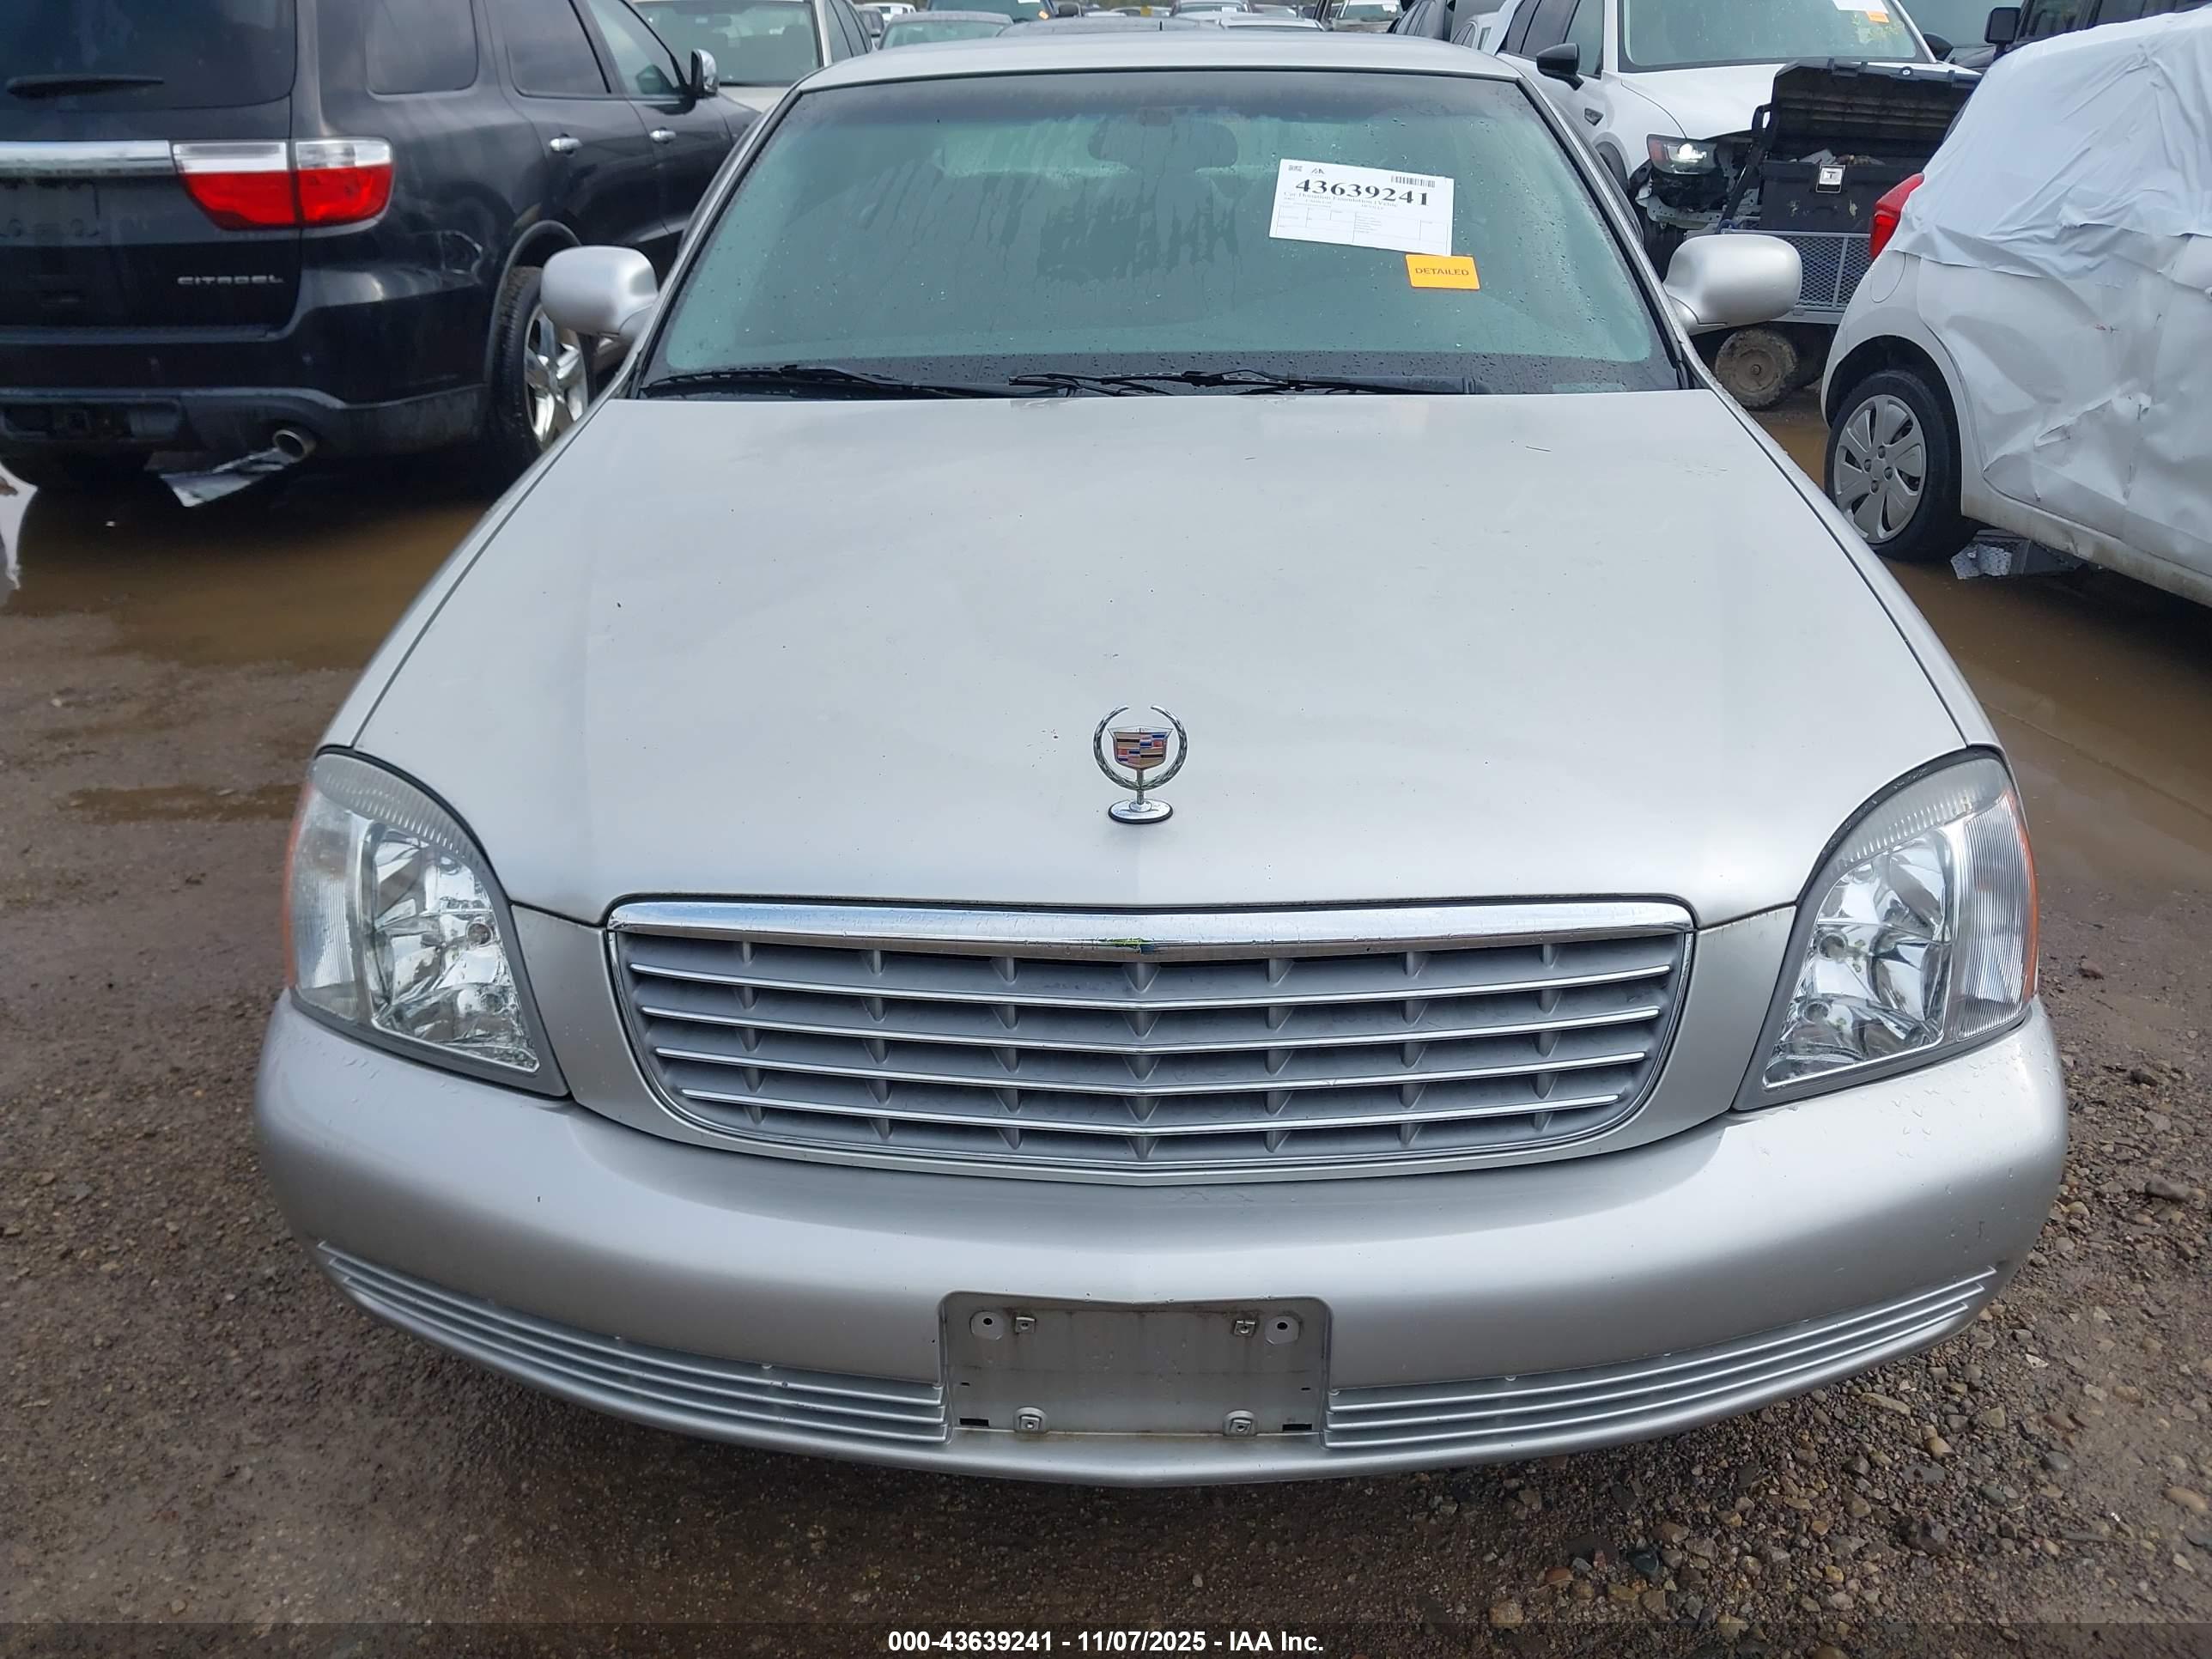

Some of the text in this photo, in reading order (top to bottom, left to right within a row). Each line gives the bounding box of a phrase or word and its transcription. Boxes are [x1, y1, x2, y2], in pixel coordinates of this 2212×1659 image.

[1295, 178, 1430, 207] 43639241
[1415, 267, 1469, 276] DETAILED
[177, 274, 284, 285] CITADEL
